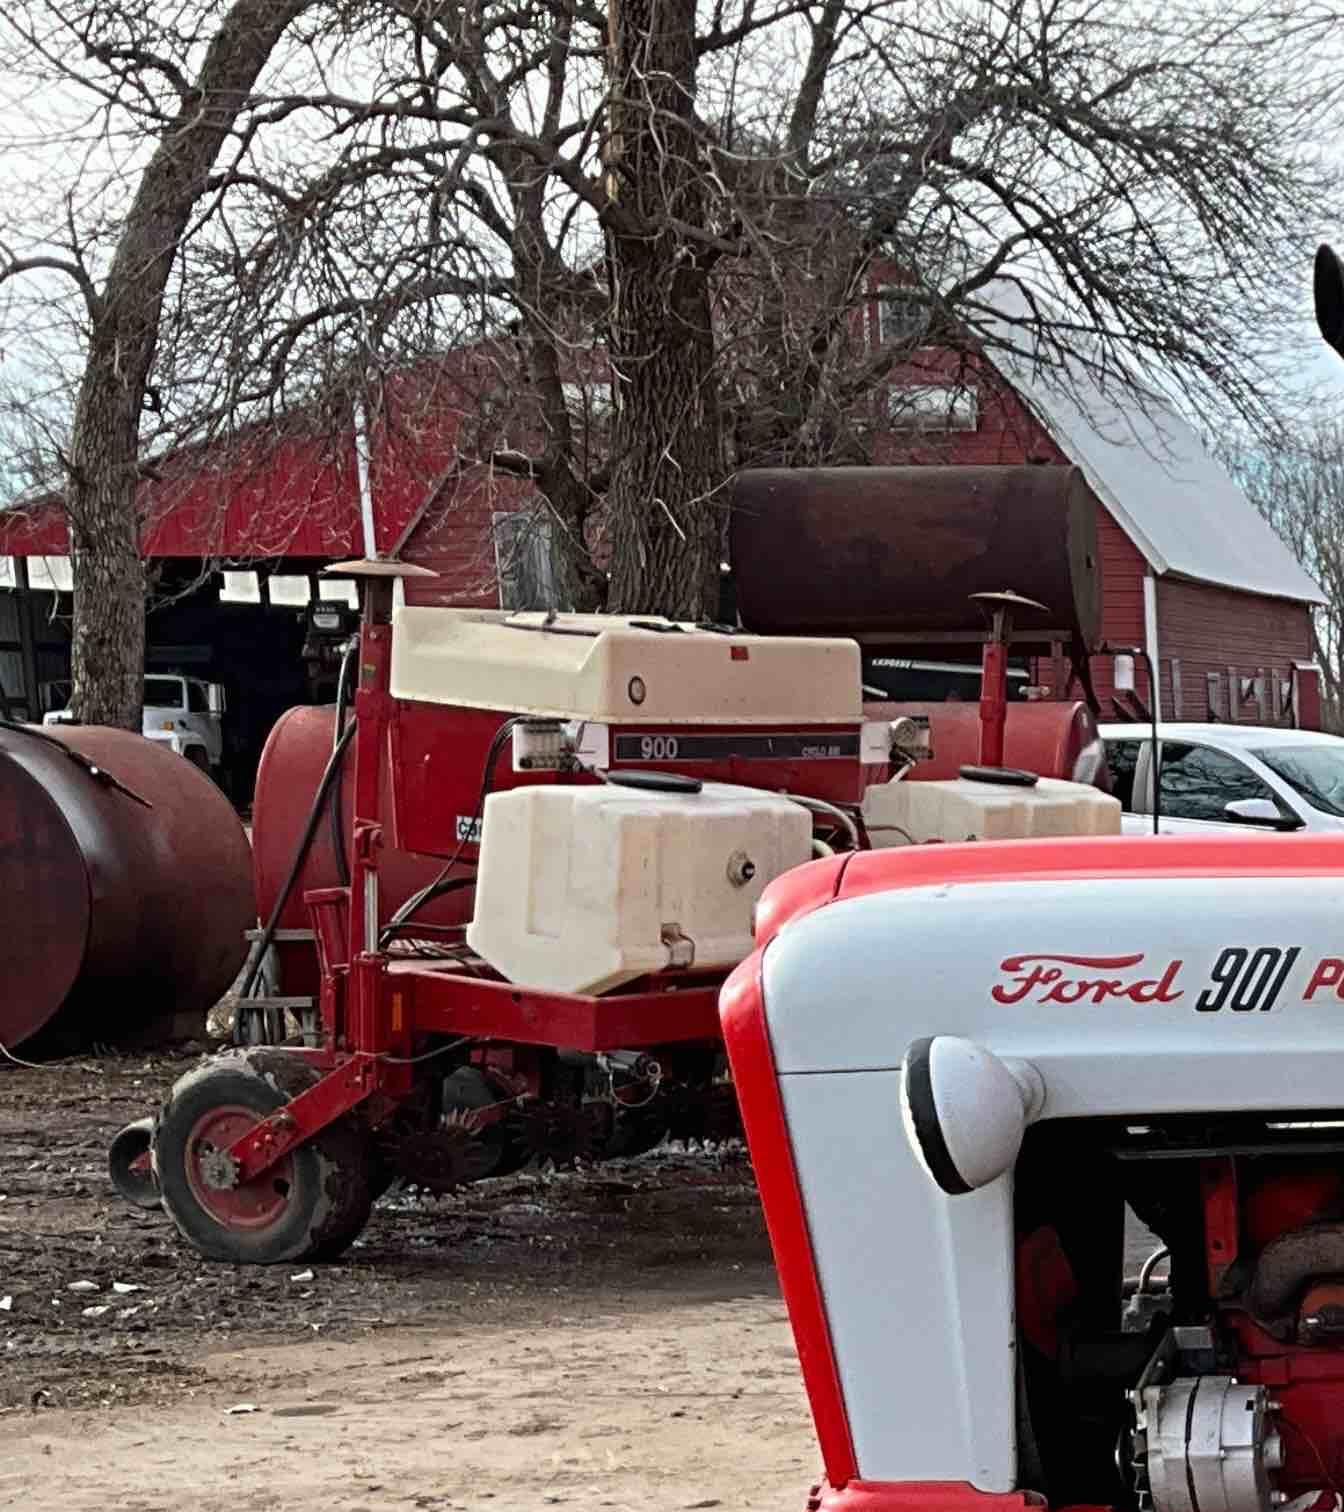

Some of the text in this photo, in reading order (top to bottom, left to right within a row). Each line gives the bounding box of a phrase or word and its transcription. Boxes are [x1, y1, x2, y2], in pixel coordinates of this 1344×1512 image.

[640, 735, 679, 760] 900
[991, 953, 1184, 1004] Ford
[1195, 946, 1303, 1012] 901
